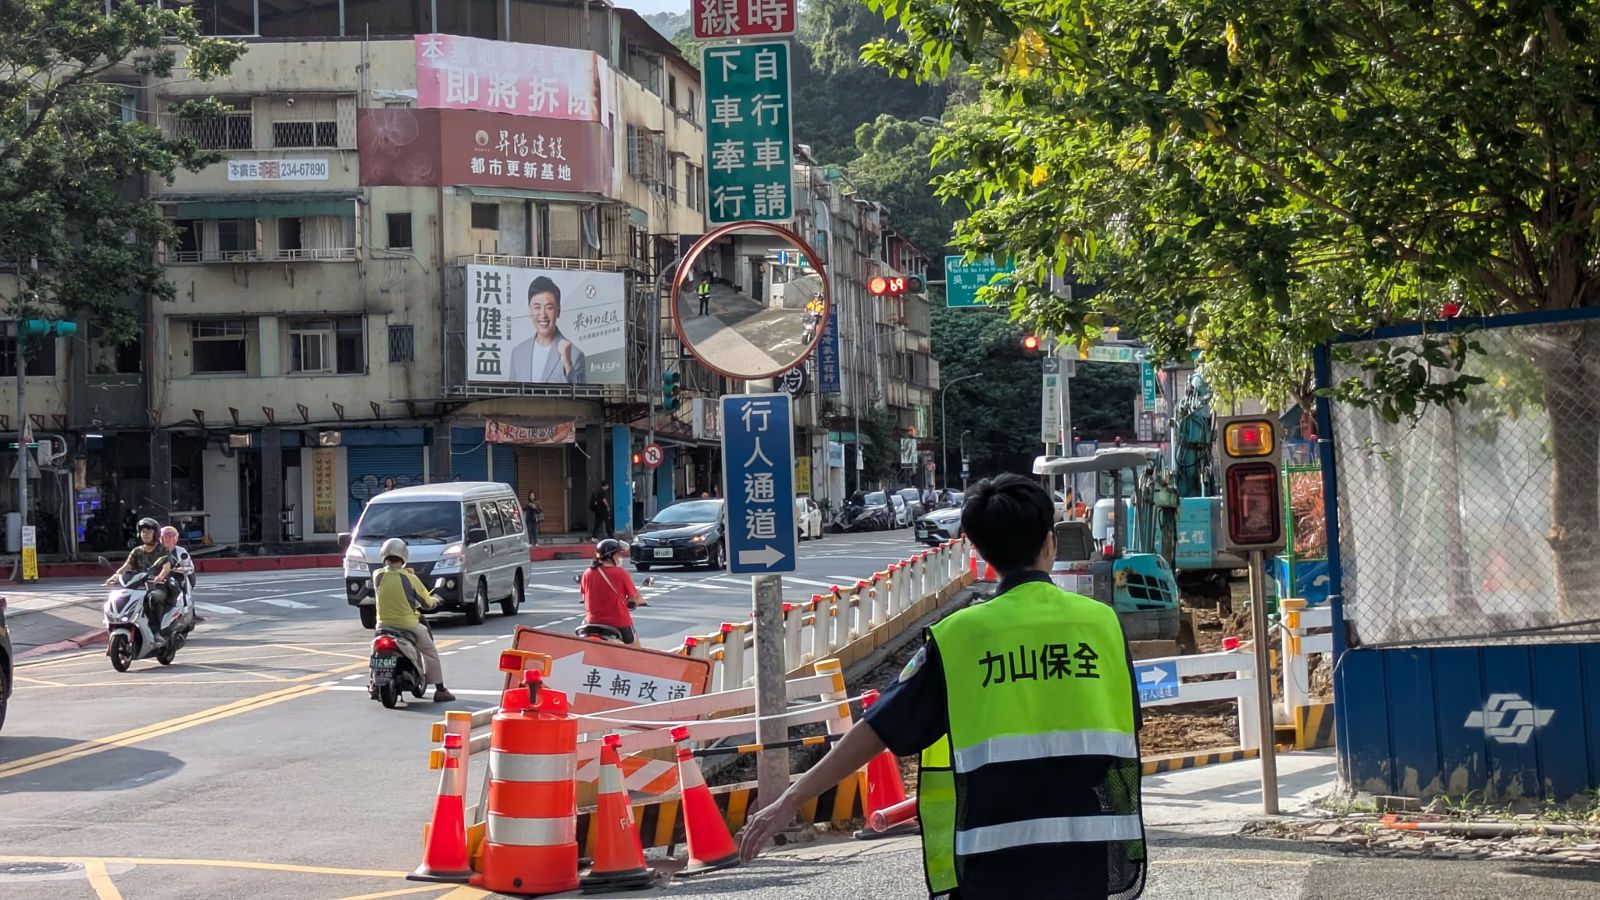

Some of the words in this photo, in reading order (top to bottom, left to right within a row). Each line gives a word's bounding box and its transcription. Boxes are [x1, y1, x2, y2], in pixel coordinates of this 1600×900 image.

[471, 157, 571, 181] 都市更新基地
[710, 51, 746, 218] 下車牽行
[751, 48, 786, 216] 自行車請
[281, 163, 326, 177] 234-67890
[476, 271, 501, 375] 洪健益
[741, 401, 777, 540] 行人通道
[583, 668, 687, 702] 車輛改道
[979, 642, 1100, 688] 力山保全
